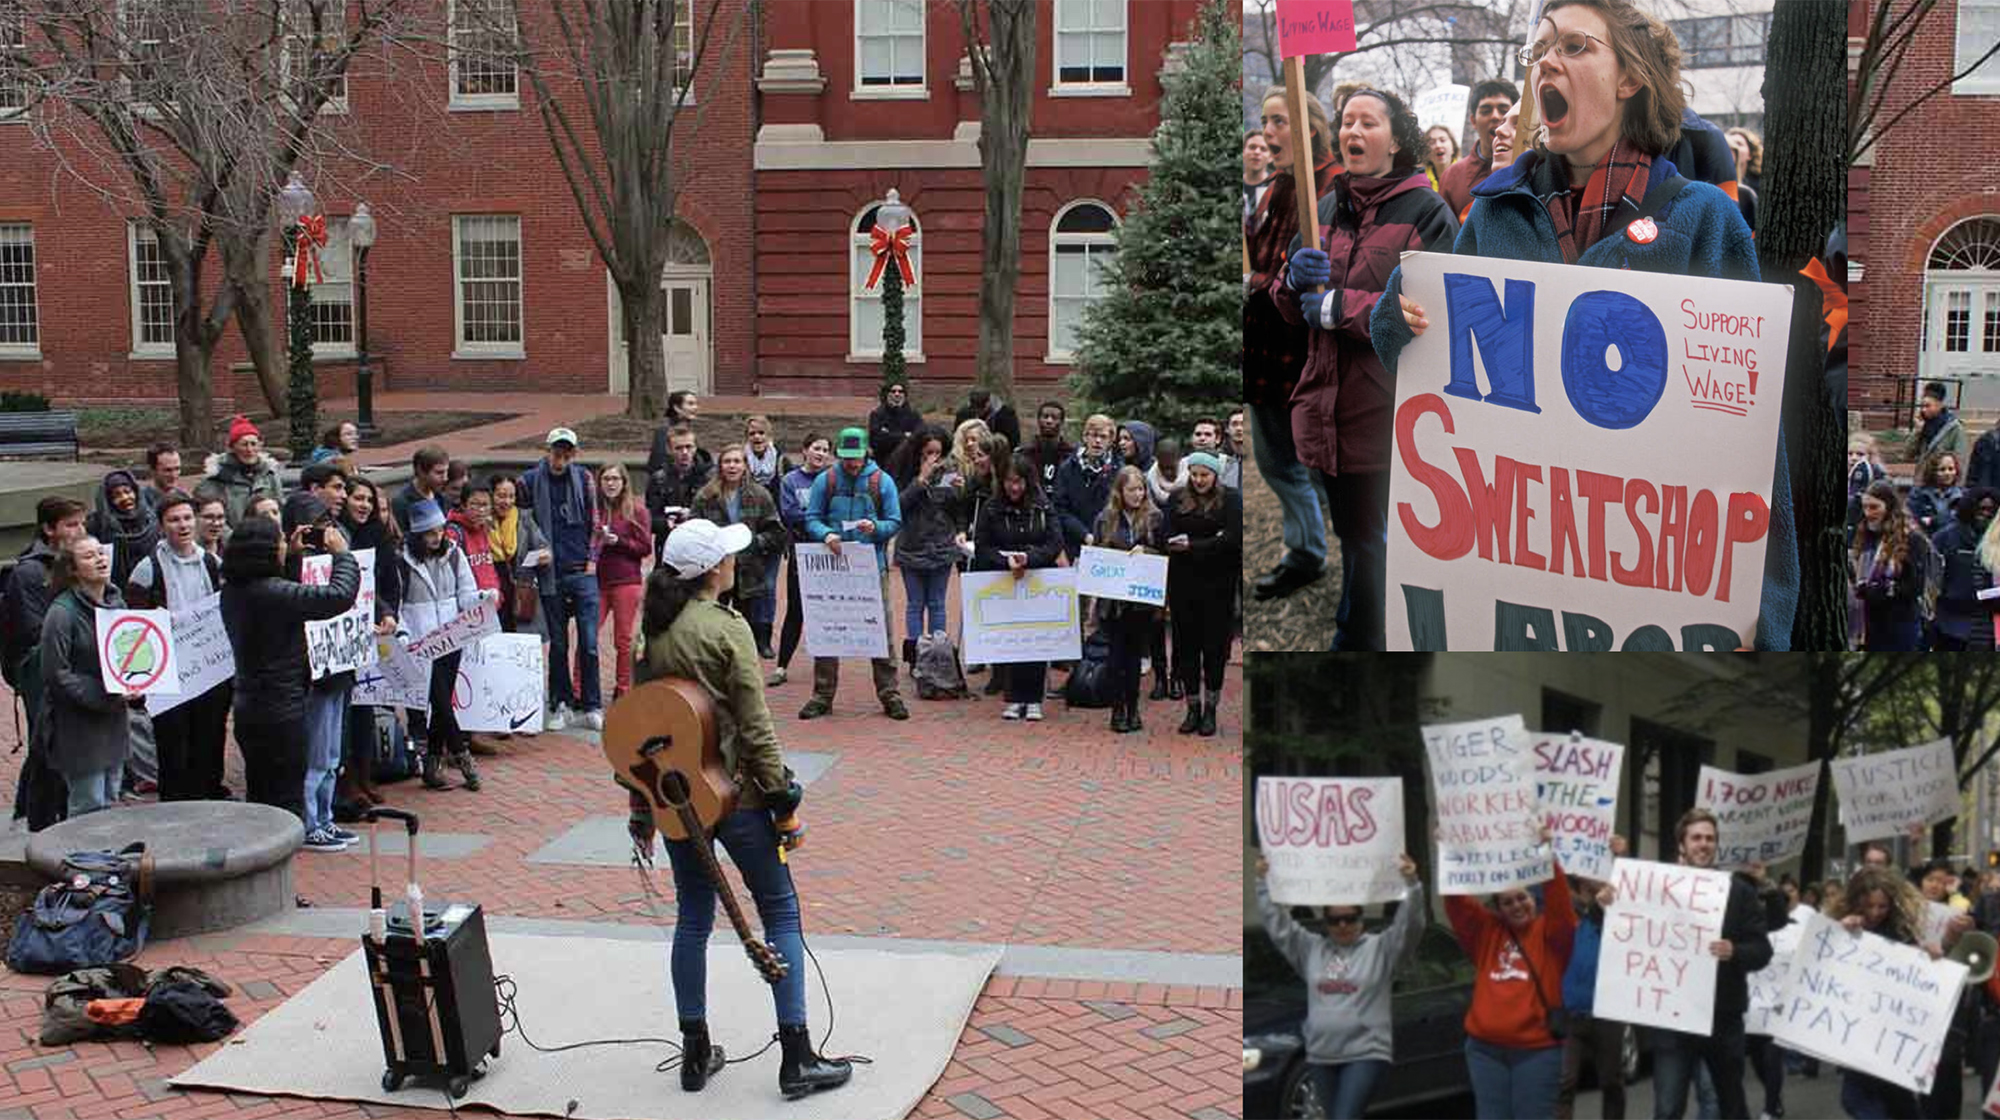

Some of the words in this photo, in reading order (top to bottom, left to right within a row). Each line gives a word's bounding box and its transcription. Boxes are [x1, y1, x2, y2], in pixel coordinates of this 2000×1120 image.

[1317, 11, 1350, 33] WAGE
[1681, 298, 1765, 340] SUPPORT
[1443, 272, 1669, 430] NO
[1684, 337, 1758, 371] LIVING
[1682, 364, 1759, 406] WAGE!
[1395, 392, 1771, 603] SWEATSHOP
[1429, 727, 1518, 761] TIGER
[1533, 741, 1613, 781] SLASH
[1547, 781, 1598, 807] THE
[1706, 778, 1767, 804] 1,700
[1260, 780, 1378, 848] USAS
[1613, 912, 1714, 955] JUST
[1626, 951, 1689, 987] PAY
[1636, 986, 1680, 1017] IT.
[1788, 996, 1861, 1046] PAY
